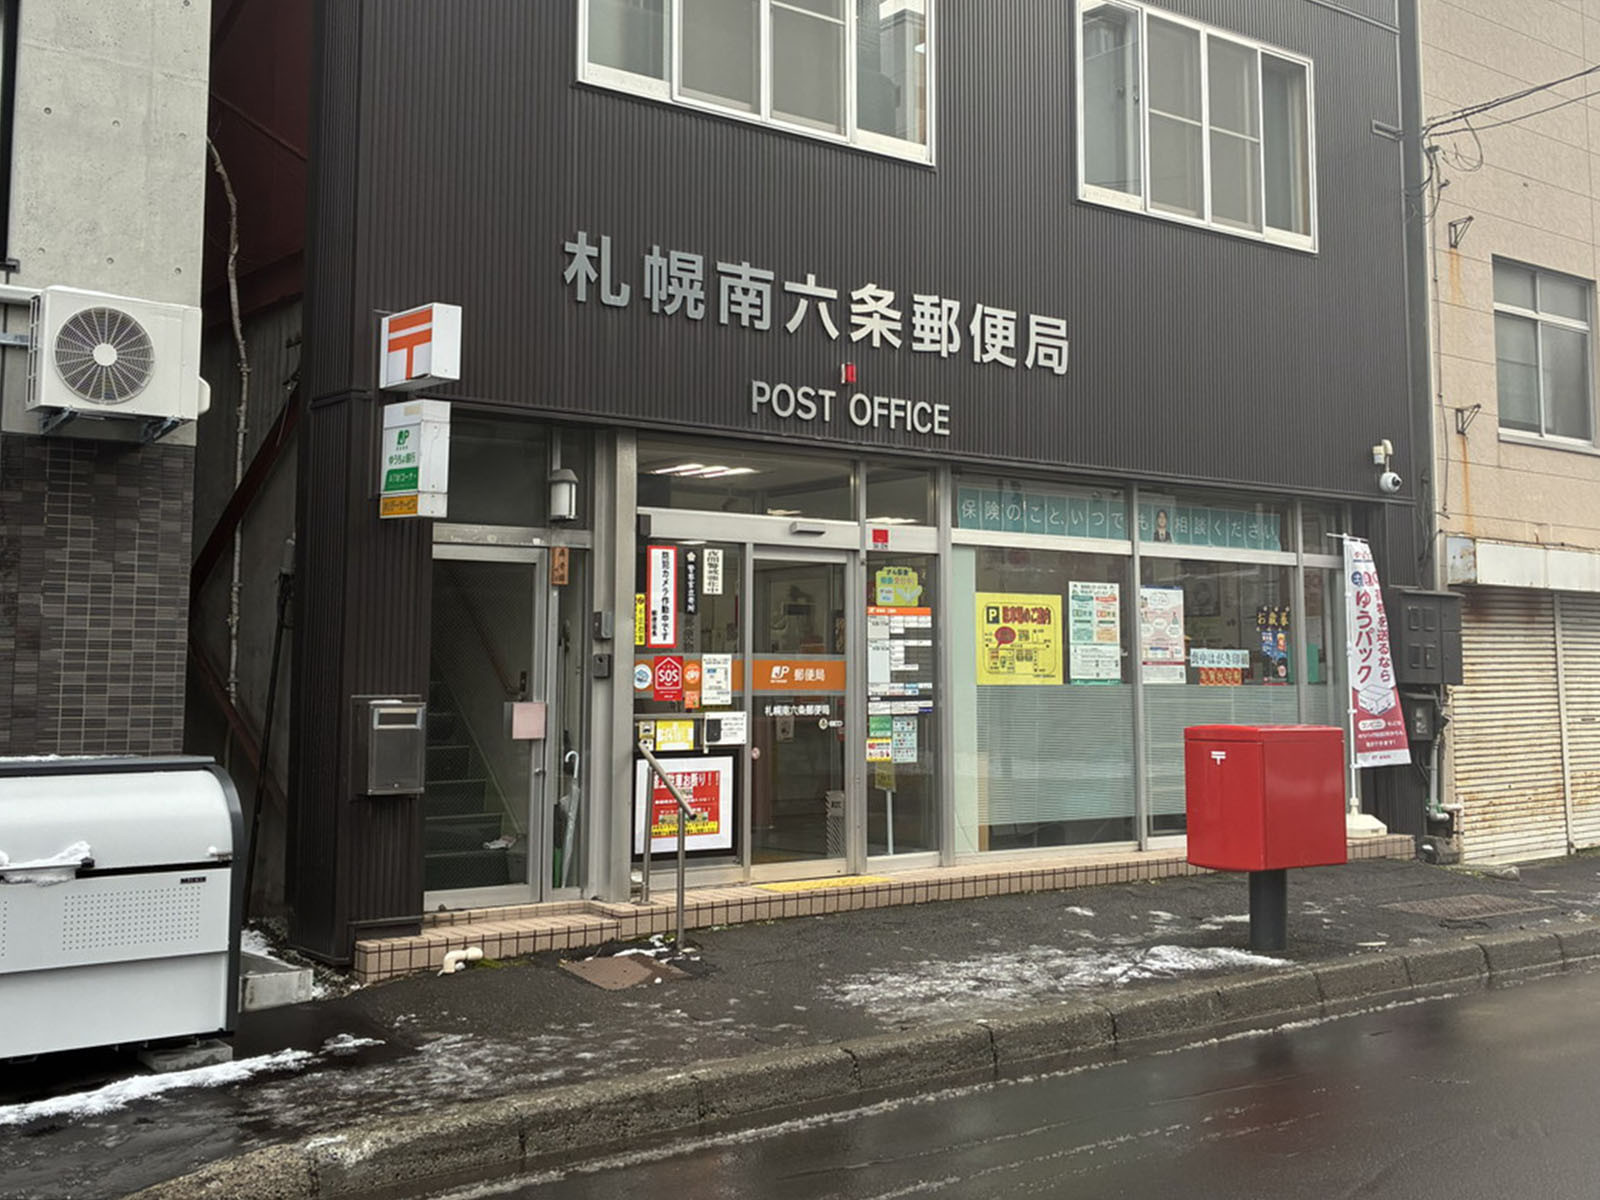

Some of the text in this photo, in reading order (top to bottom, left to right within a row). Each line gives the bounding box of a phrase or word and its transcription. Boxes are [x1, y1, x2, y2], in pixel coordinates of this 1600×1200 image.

[563, 230, 1069, 376] 札幌南六条郵便局
[751, 379, 951, 436] POST OFFICE
[1355, 589, 1374, 684] ゆうパック
[658, 668, 680, 683] SOS
[793, 667, 825, 682] 郵便局
